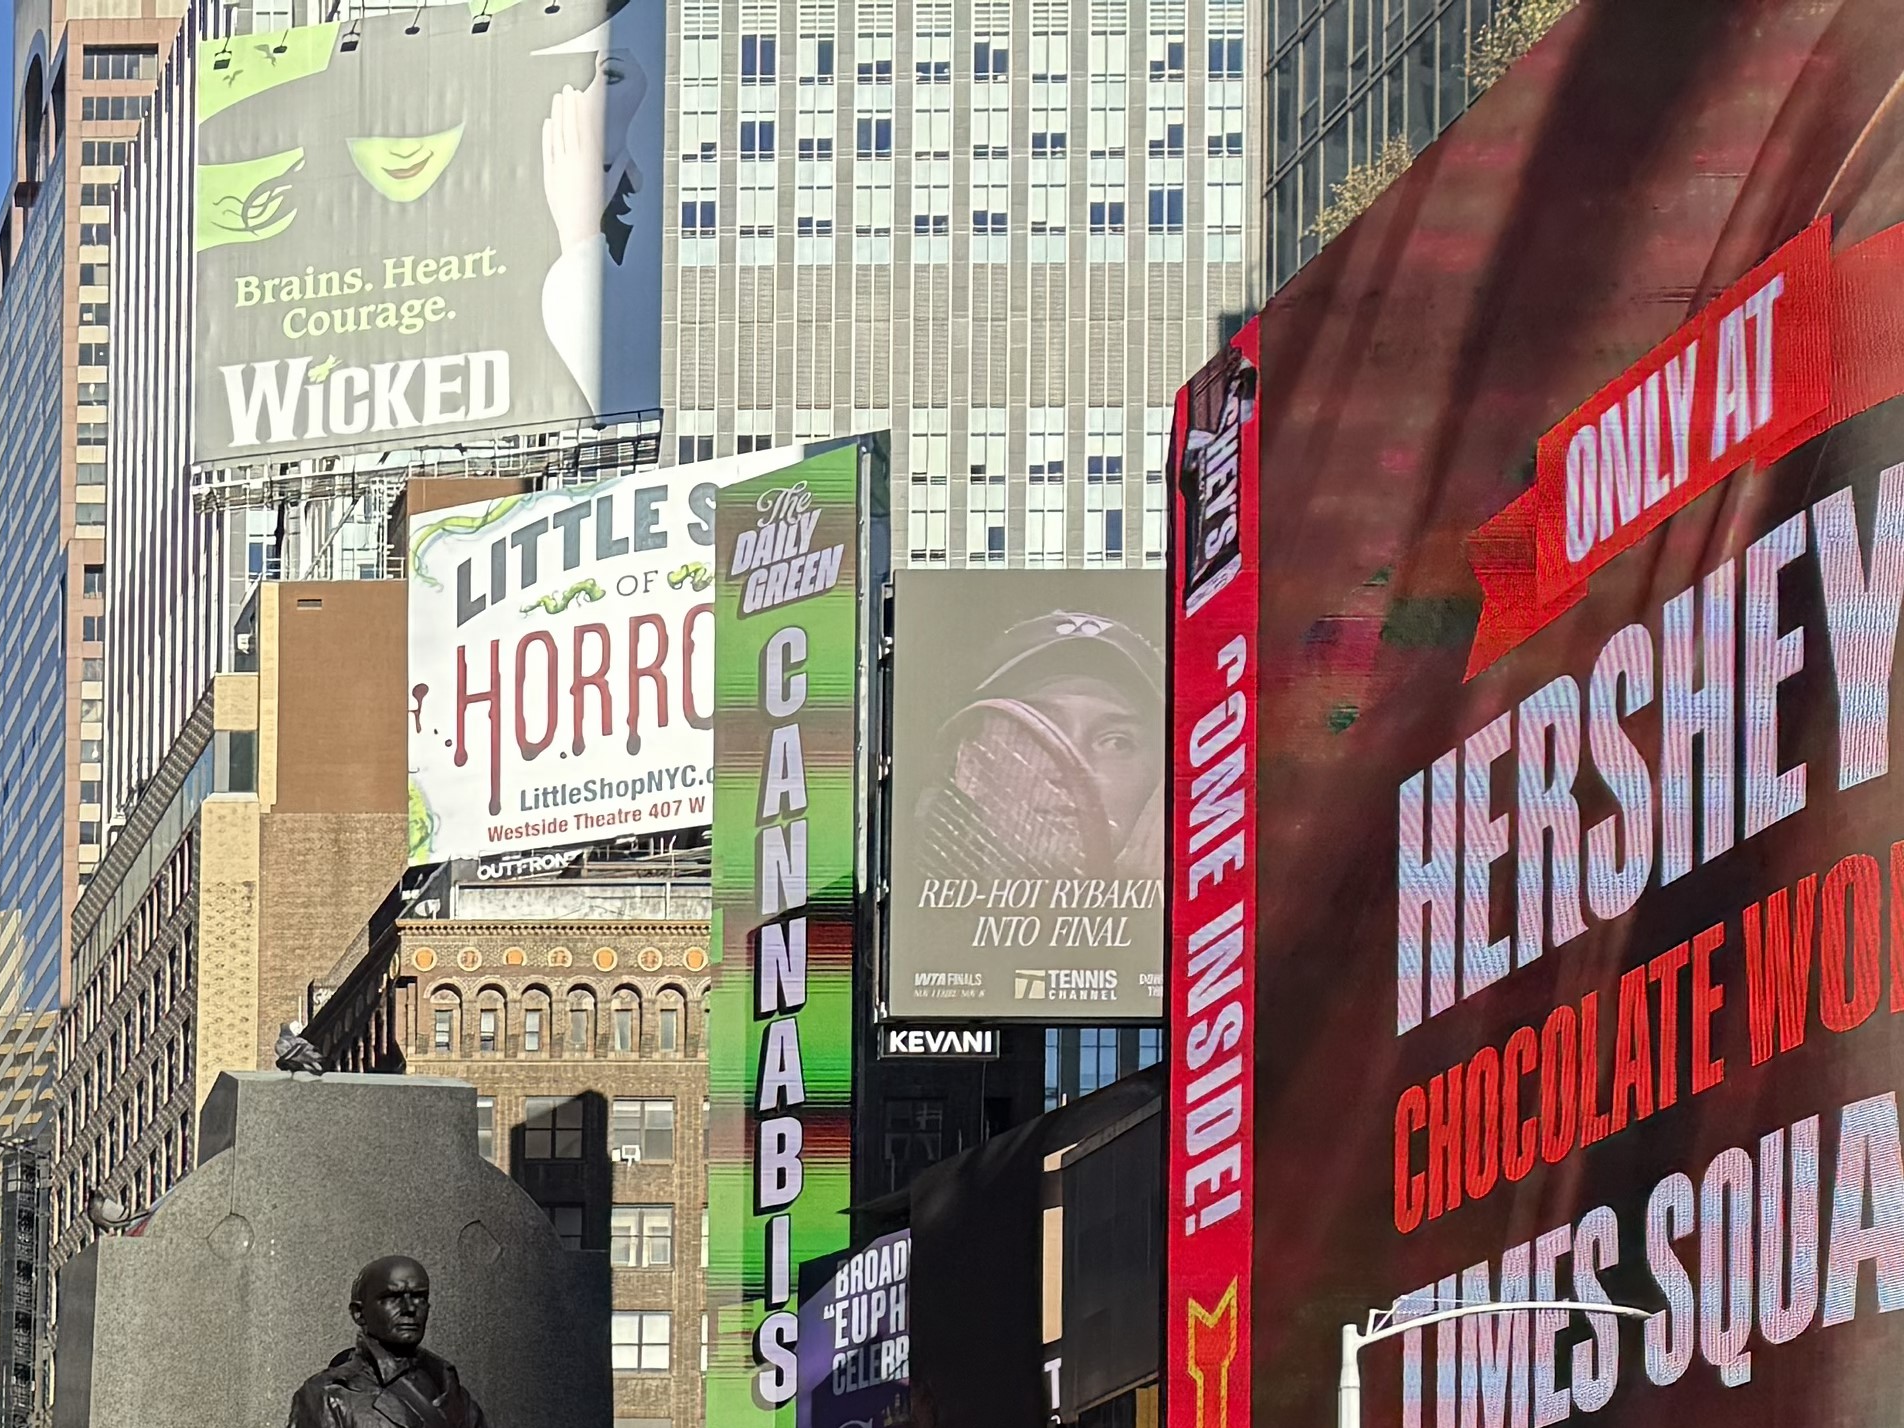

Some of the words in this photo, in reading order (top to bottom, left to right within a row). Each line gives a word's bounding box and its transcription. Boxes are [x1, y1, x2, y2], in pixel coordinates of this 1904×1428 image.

[235, 266, 374, 309] Brains.
[385, 248, 508, 289] Heart.
[283, 292, 456, 340] Courage.
[1564, 339, 1698, 564] ONLY
[1712, 274, 1784, 461] AT
[757, 480, 812, 527] The
[456, 484, 669, 628] LITTLE
[731, 509, 822, 576] DAILY
[616, 571, 658, 597] OF
[741, 544, 844, 615] GREEN
[454, 603, 715, 816] HORRO
[488, 819, 569, 843] Westside
[574, 806, 641, 830] Theatre
[649, 801, 682, 819] 407
[688, 797, 705, 814] W
[918, 880, 1049, 908] RED-HOT
[972, 916, 1040, 947] INTO
[1050, 916, 1132, 947] FINAL
[948, 973, 982, 986] FINALS
[1048, 970, 1118, 988] TENNIS
[1048, 991, 1117, 1000] CHANNEL
[754, 626, 808, 1408] CANNABIS
[890, 1030, 992, 1052] KEVANI
[1392, 925, 1725, 1238] CHOCOLATE
[1740, 836, 1904, 1070] WO
[1186, 904, 1244, 1236] INSIDE!
[835, 1238, 911, 1299] BROAD
